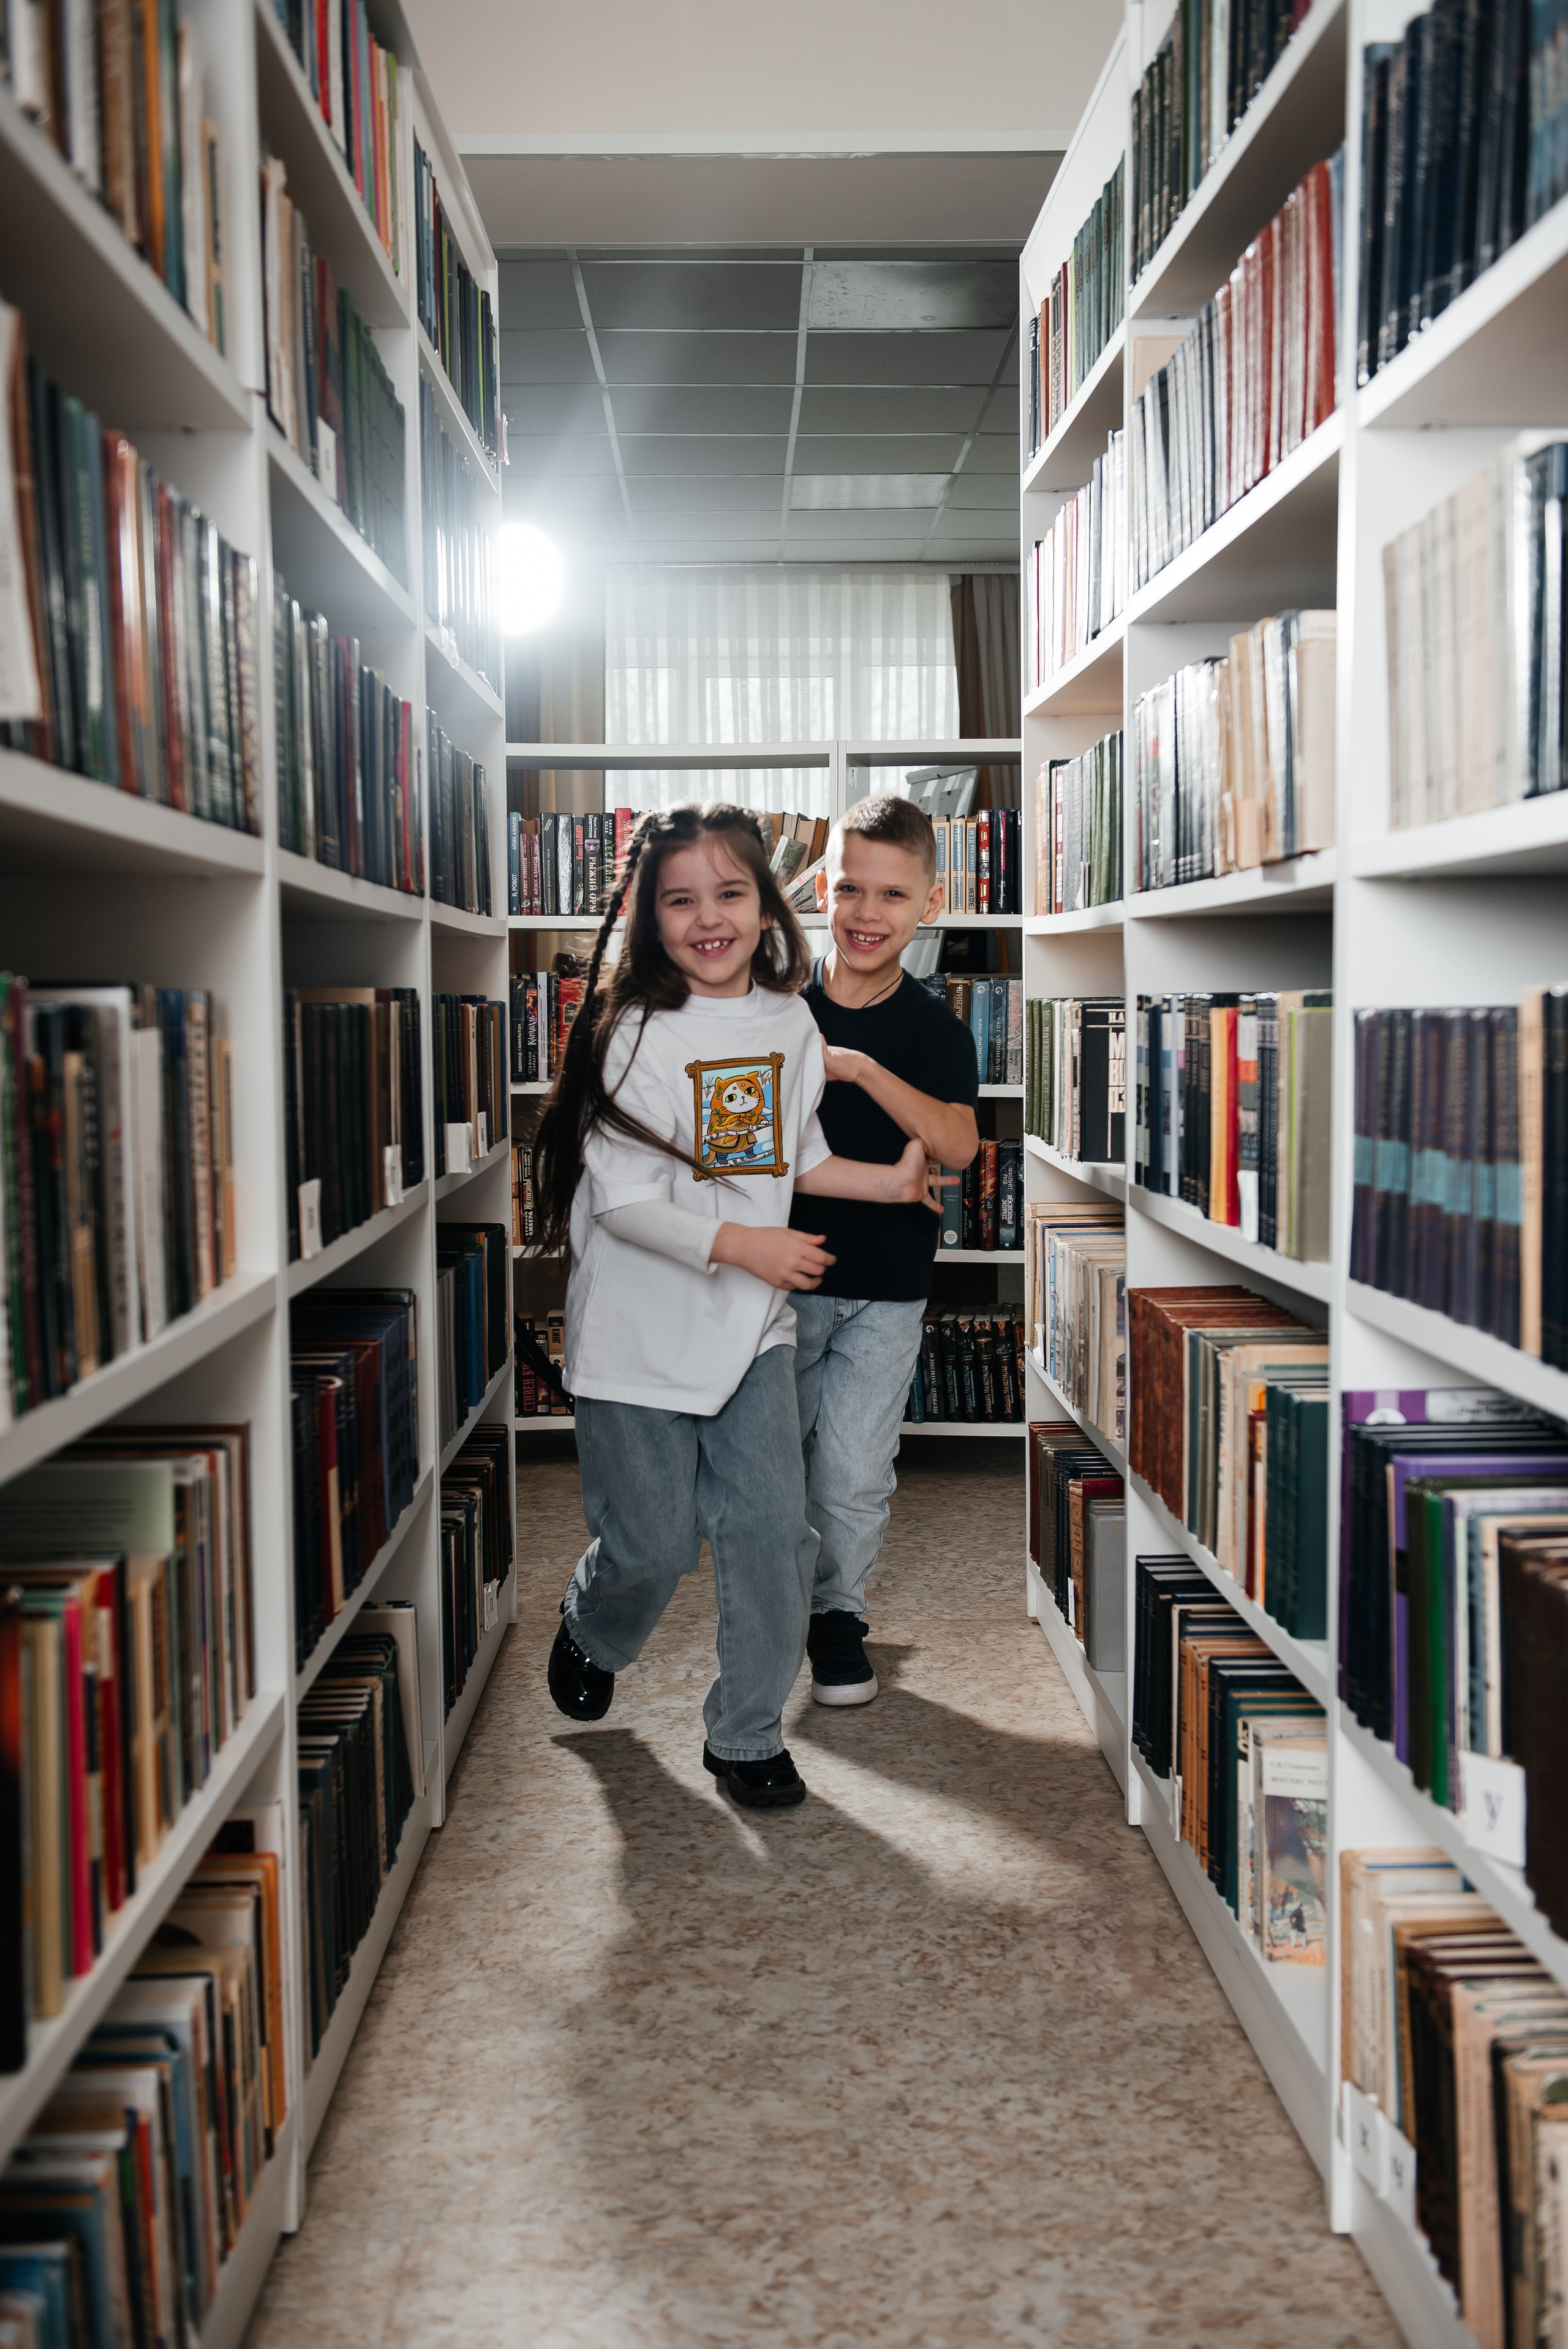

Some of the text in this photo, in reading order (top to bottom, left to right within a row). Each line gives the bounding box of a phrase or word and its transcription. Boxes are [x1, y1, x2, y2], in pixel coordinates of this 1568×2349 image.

[589, 856, 598, 891] РЫЖИЙ
[527, 1015, 537, 1045] КАРАВАЛЬ
[523, 1179, 532, 1210] ЖЕЛЯЗНЫ
[551, 1328, 561, 1344] КИНГ
[523, 1378, 536, 1411] СТИВЕН
